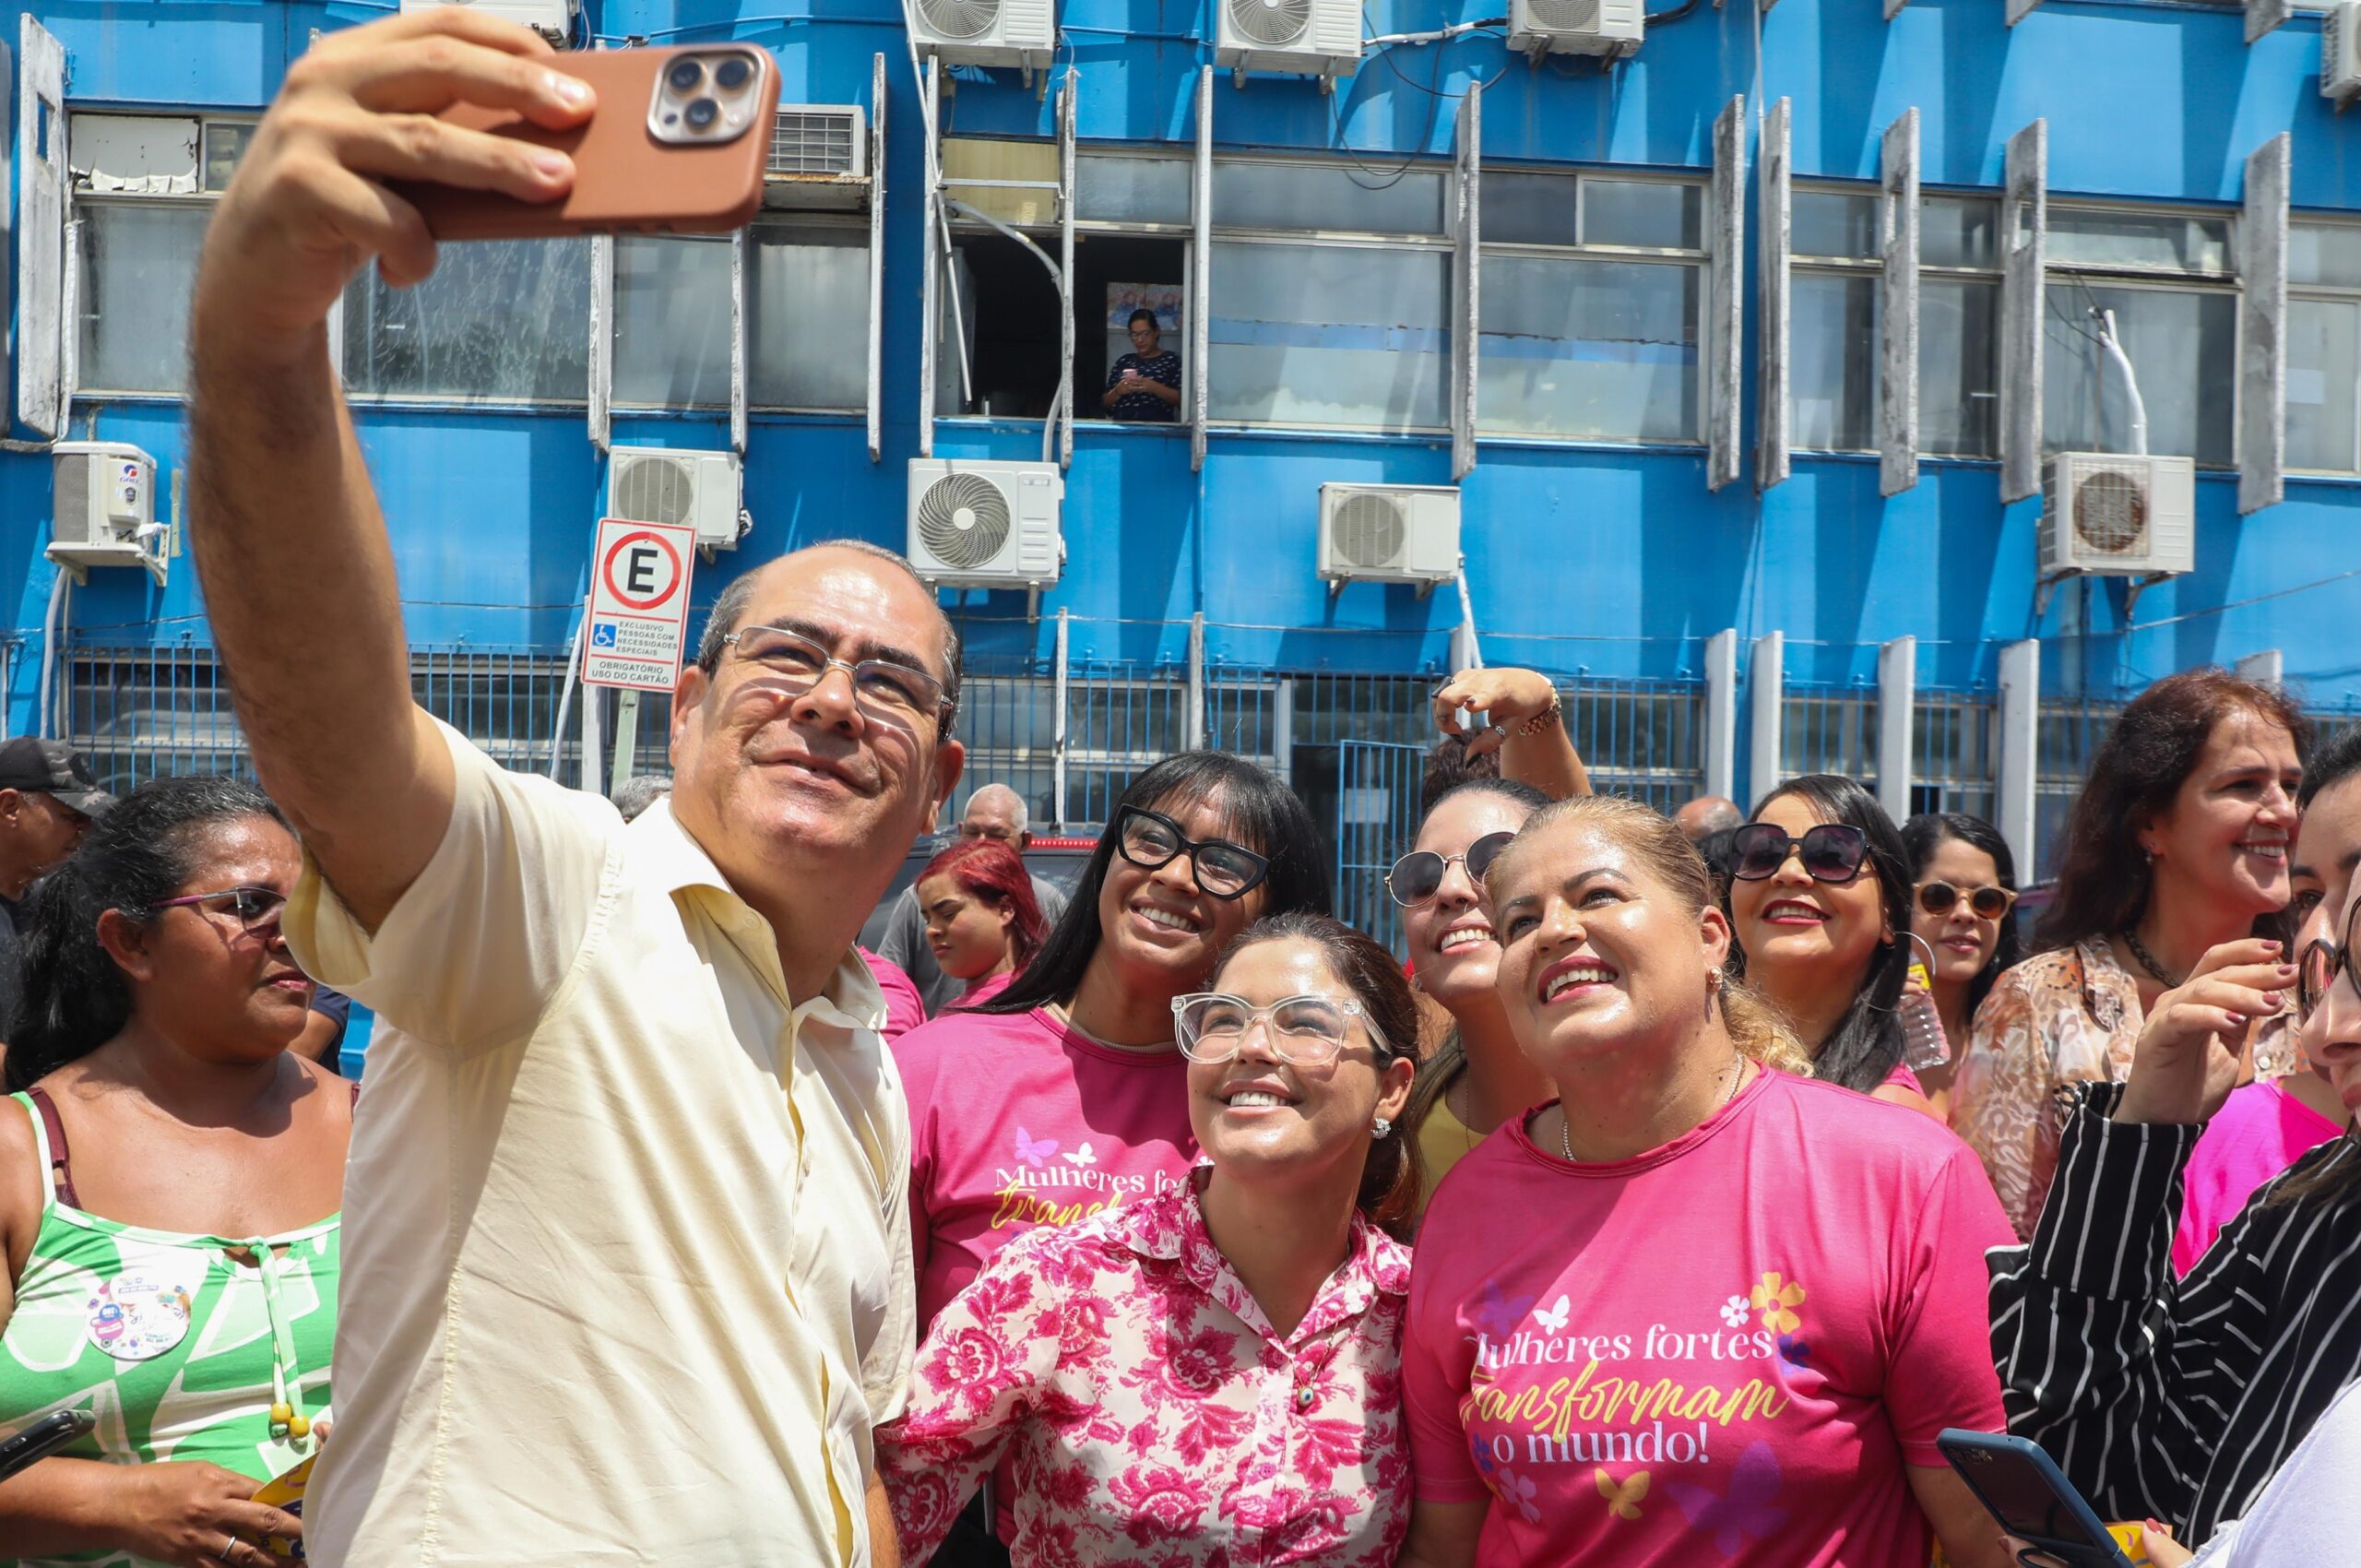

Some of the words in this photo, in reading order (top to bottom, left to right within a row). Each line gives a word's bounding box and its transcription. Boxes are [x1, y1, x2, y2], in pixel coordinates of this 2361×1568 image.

[627, 547, 658, 593] E
[619, 621, 664, 632] EXCLUSIVO
[618, 629, 656, 638] PESSOAS
[657, 633, 675, 641] COM
[617, 637, 678, 649] NECESSIDADES
[616, 647, 658, 656] ESPECIAIS
[599, 660, 663, 674] OBRIGATÓRIO
[592, 670, 611, 678] USO
[613, 671, 628, 680] DO
[629, 673, 669, 684] CARTÃO
[995, 1164, 1146, 1194] Mulheres
[1643, 1323, 1774, 1360] fortes
[1493, 1433, 1515, 1464] o
[1525, 1420, 1711, 1464] mundo!
